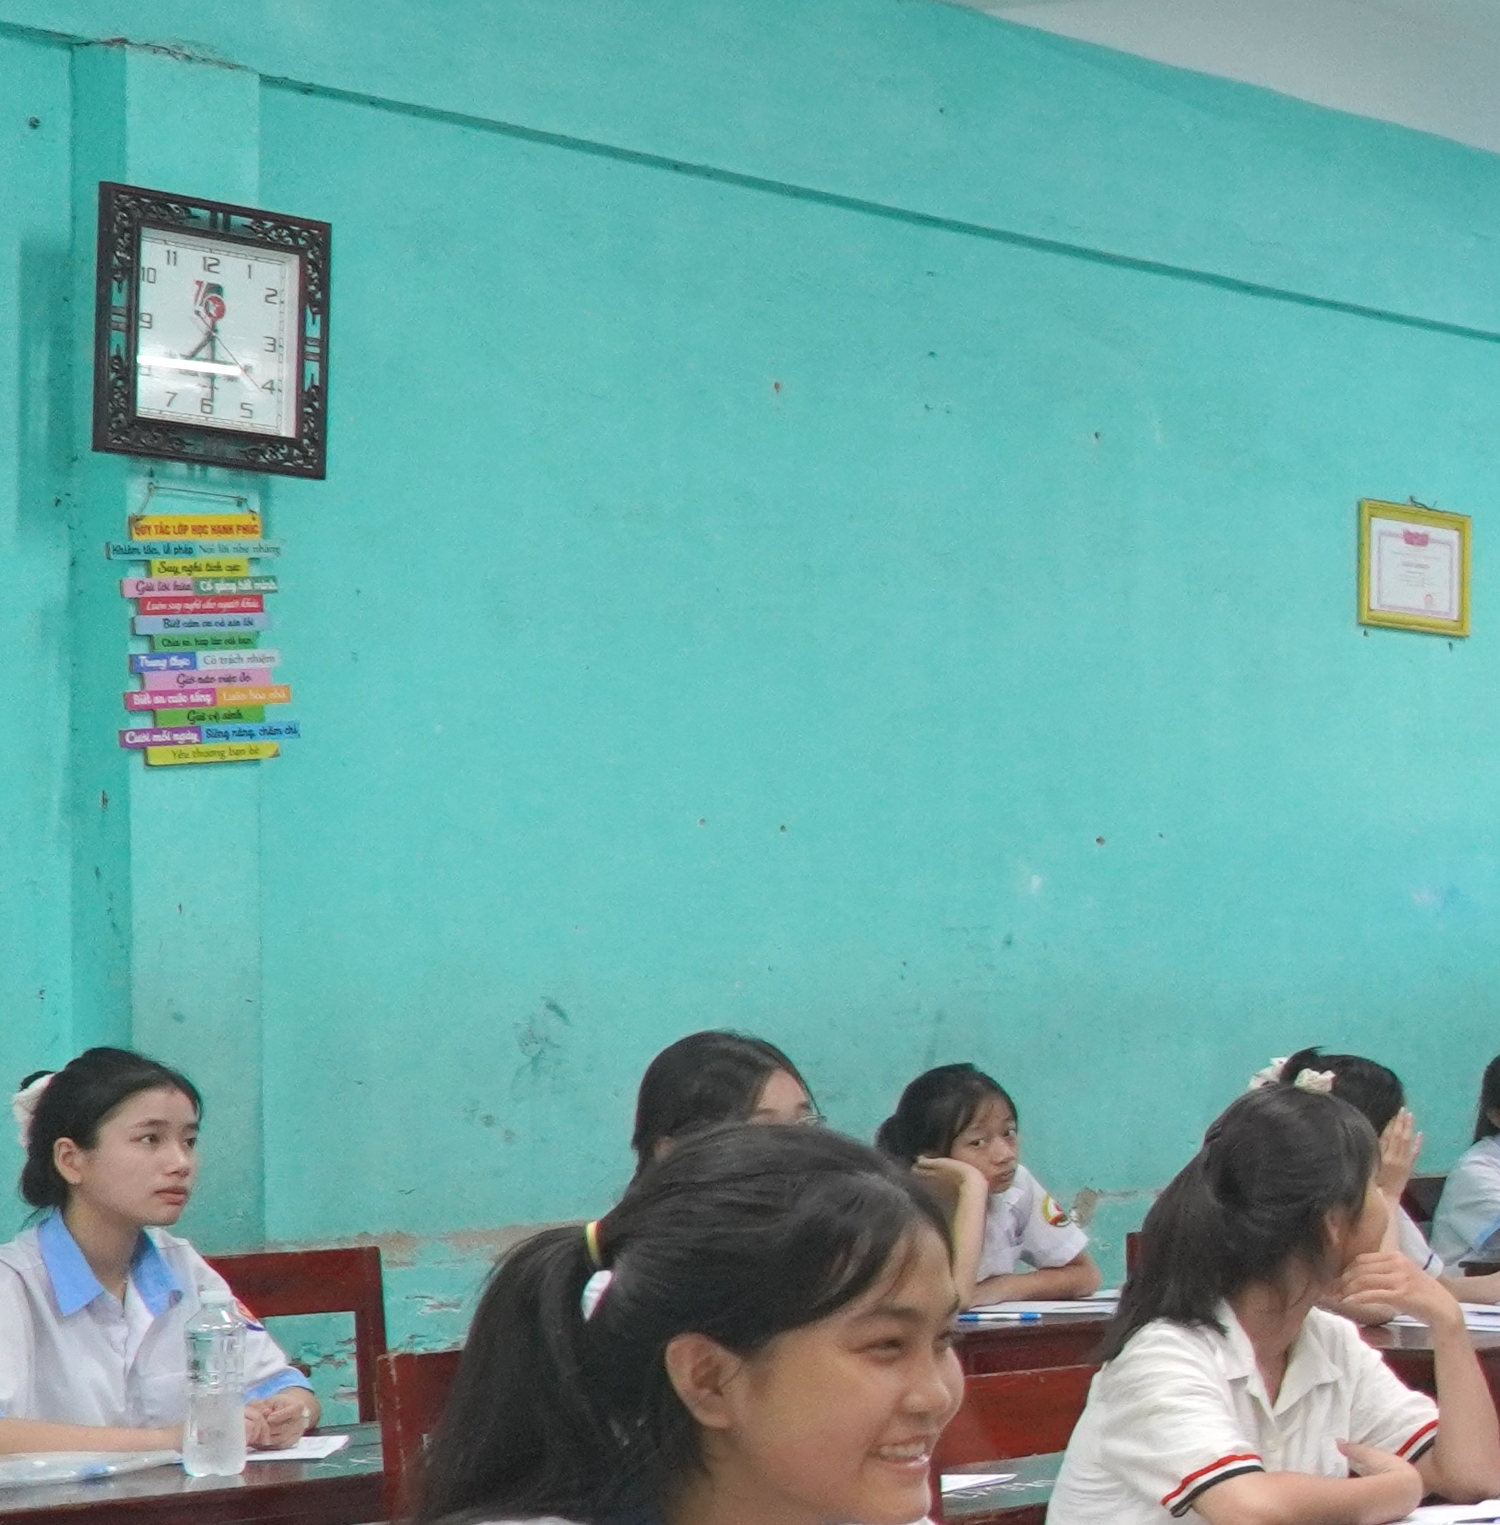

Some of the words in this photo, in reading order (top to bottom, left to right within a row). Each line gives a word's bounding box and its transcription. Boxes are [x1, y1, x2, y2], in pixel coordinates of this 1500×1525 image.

[167, 250, 177, 266] 11
[202, 256, 220, 274] 12
[140, 267, 156, 284] 10
[247, 264, 252, 279] 1
[264, 287, 278, 305] 2
[138, 312, 153, 329] 9
[263, 336, 276, 352] 3
[261, 379, 276, 394] 4
[165, 391, 178, 408] 7
[200, 398, 214, 415] 6
[240, 402, 253, 419] 5
